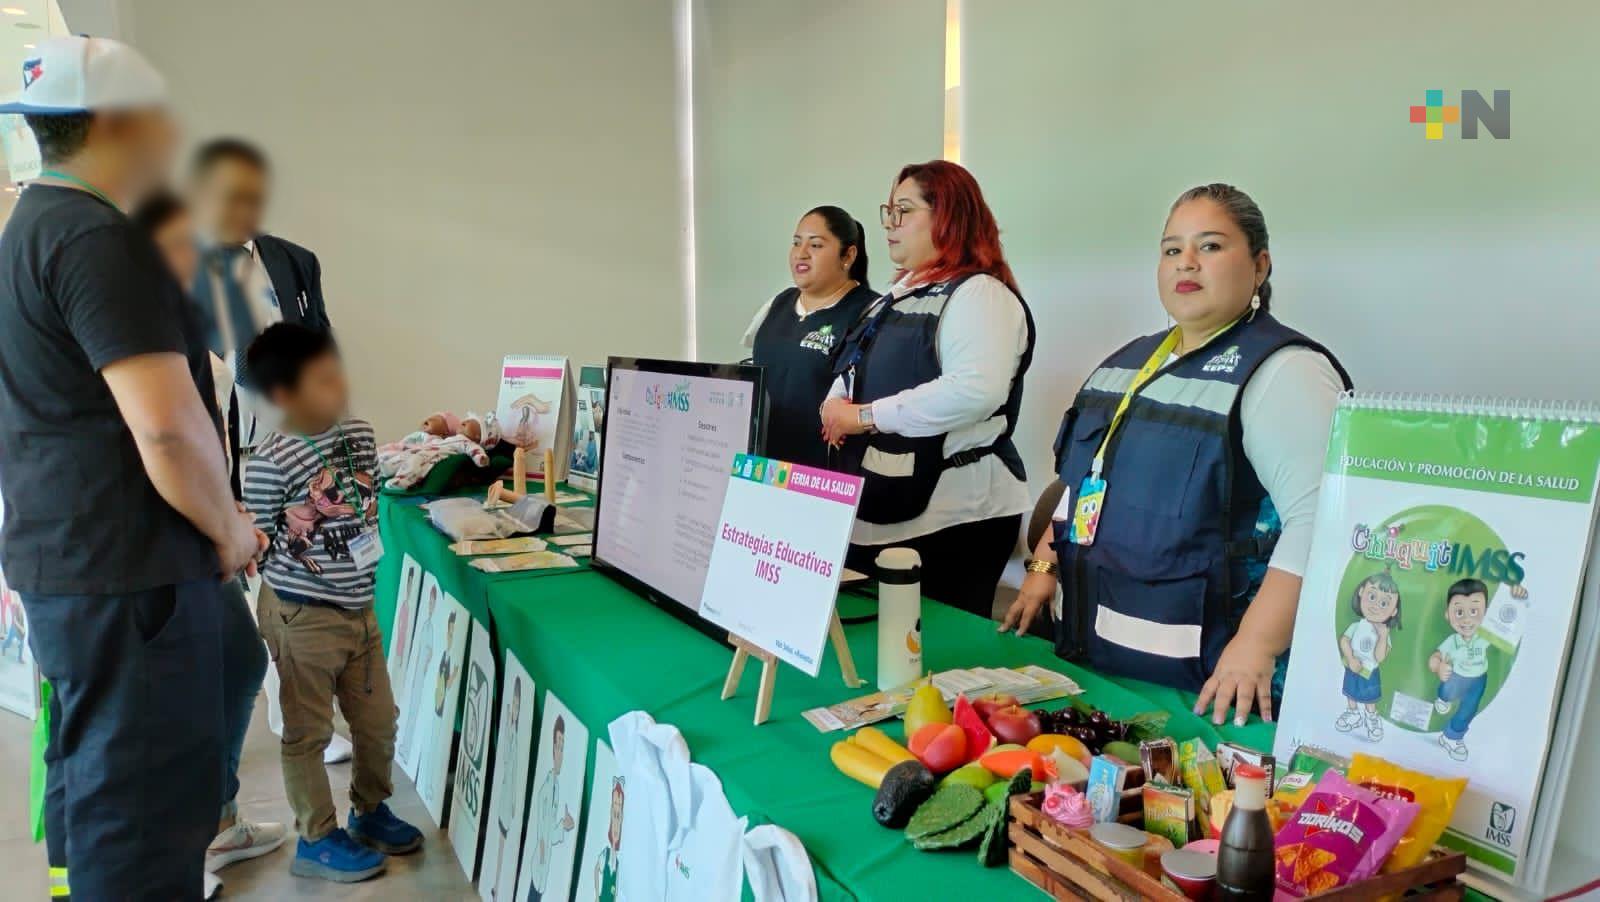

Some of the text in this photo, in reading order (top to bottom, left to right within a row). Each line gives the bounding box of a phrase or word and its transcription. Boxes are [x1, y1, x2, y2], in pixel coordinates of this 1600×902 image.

[790, 471, 856, 497] FERIA DE LA SALUD
[1339, 455, 1580, 491] EDUCACIÓN Y PROMOCIÓN DE LA SALUD
[721, 523, 774, 555] Estrategias
[774, 540, 833, 577] Educativas
[1352, 524, 1525, 586] ChiquitIMSS
[754, 559, 782, 585] IMSS
[456, 757, 480, 817] IMSS
[1485, 827, 1511, 847] IMSS
